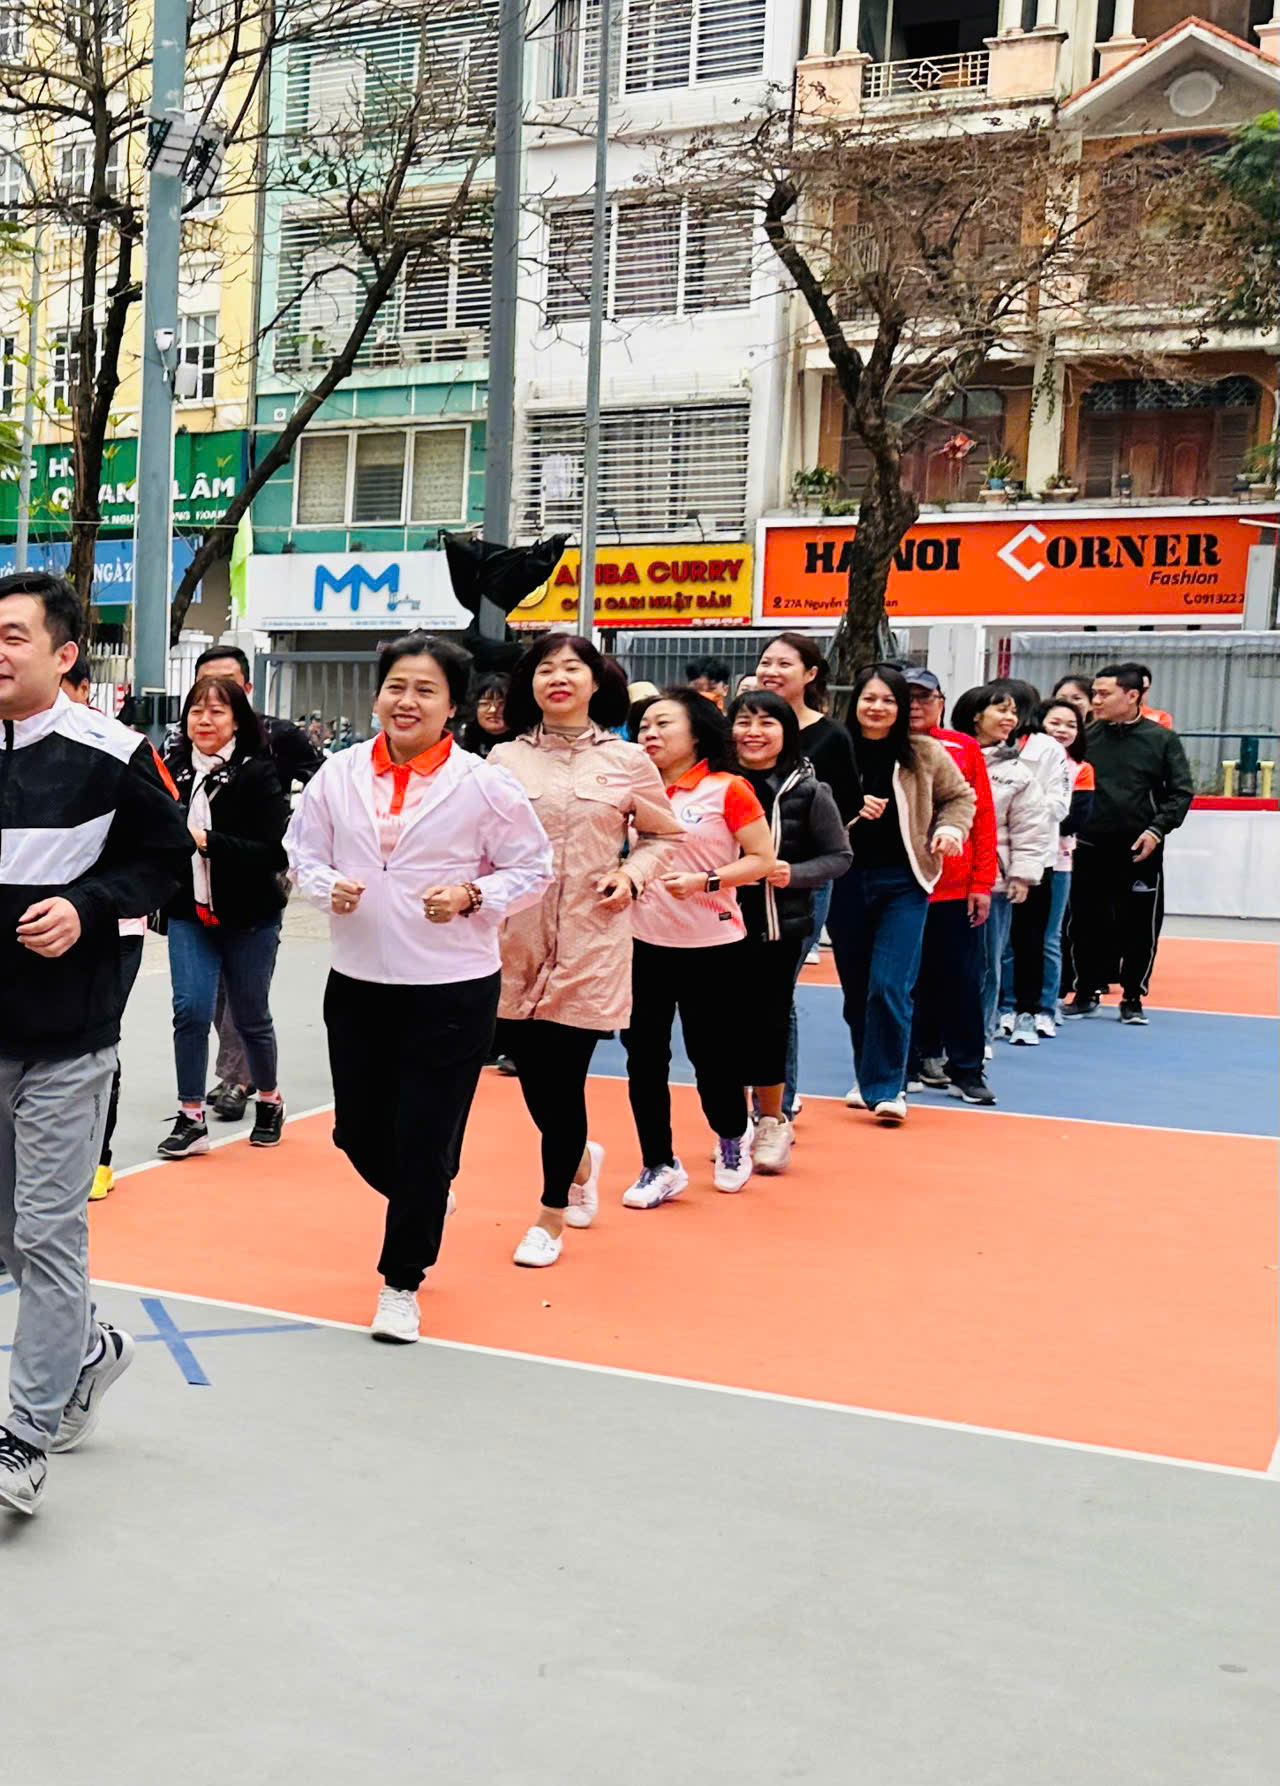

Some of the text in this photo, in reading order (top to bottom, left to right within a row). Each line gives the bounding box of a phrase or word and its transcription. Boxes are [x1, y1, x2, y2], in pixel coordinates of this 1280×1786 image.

[171, 472, 236, 500] LÂM
[93, 557, 133, 584] NGÀY
[554, 558, 744, 586] AIBA CURRY
[1149, 570, 1219, 586] Fashion
